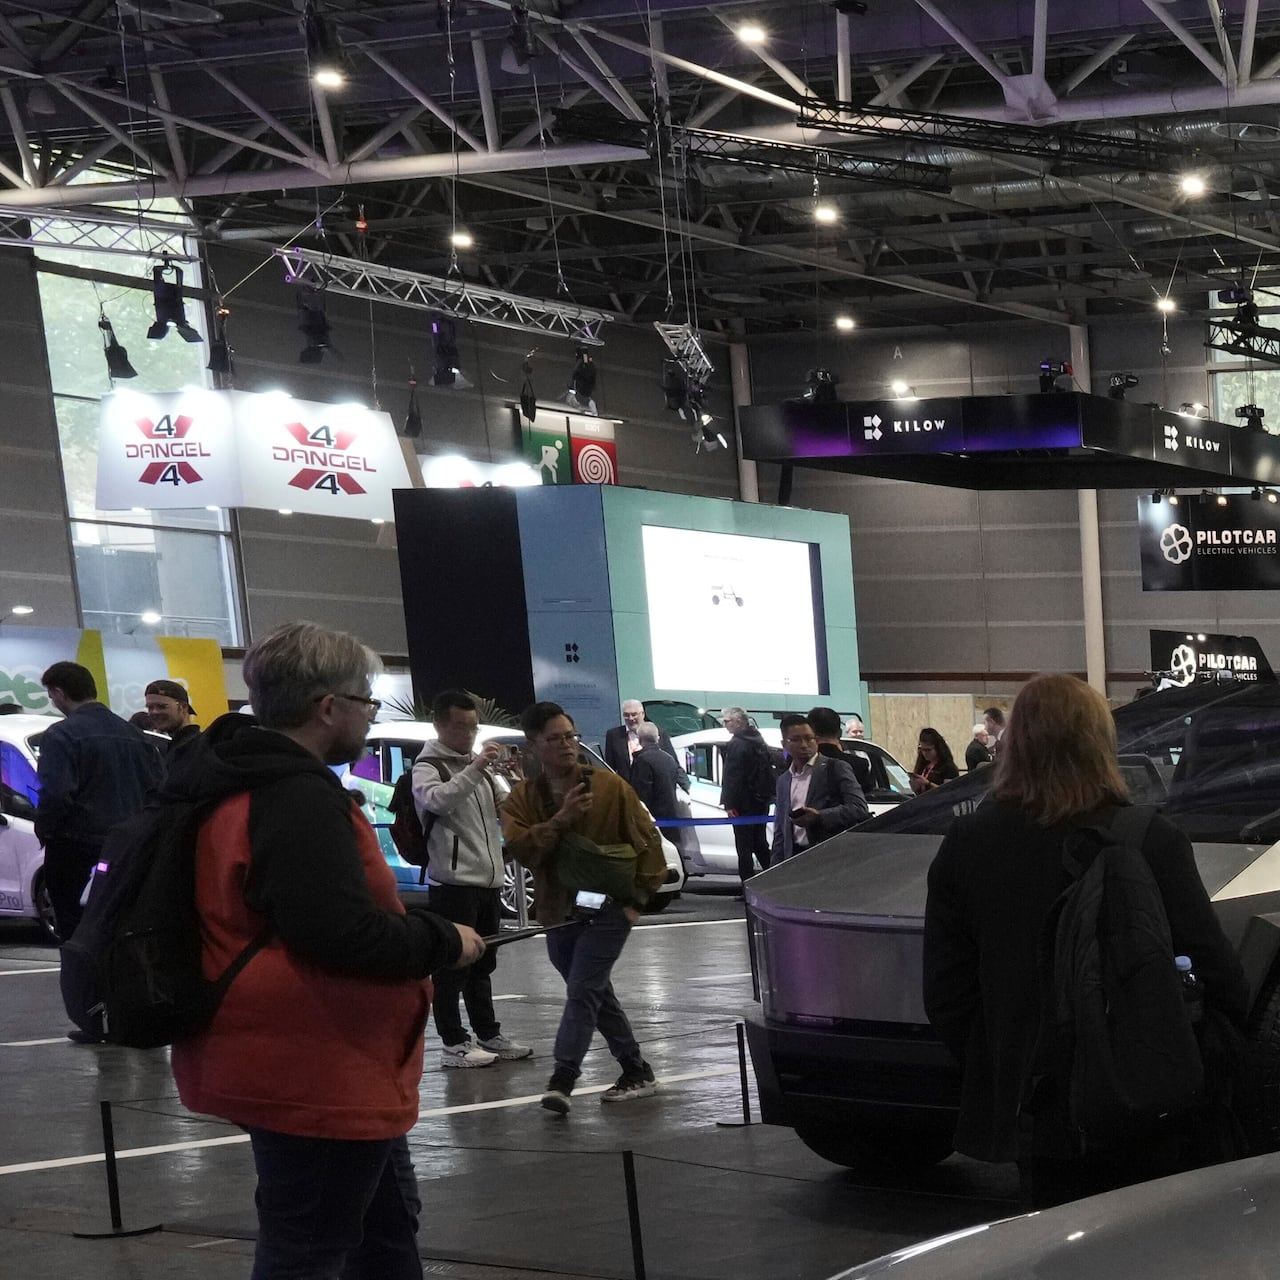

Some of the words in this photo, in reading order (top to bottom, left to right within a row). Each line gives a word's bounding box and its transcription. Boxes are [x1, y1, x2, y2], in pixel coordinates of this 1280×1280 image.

[154, 414, 176, 436] 4
[893, 420, 945, 432] KILOW
[310, 425, 334, 446] 4
[1186, 435, 1220, 452] KILOW
[126, 442, 211, 458] DANGEL
[272, 446, 377, 473] DANGEL
[160, 464, 180, 486] 4
[315, 474, 340, 495] 4
[1196, 529, 1277, 545] PILOTCAR
[1197, 547, 1235, 555] ELECTRIC
[1199, 653, 1258, 670] PILOTCAR
